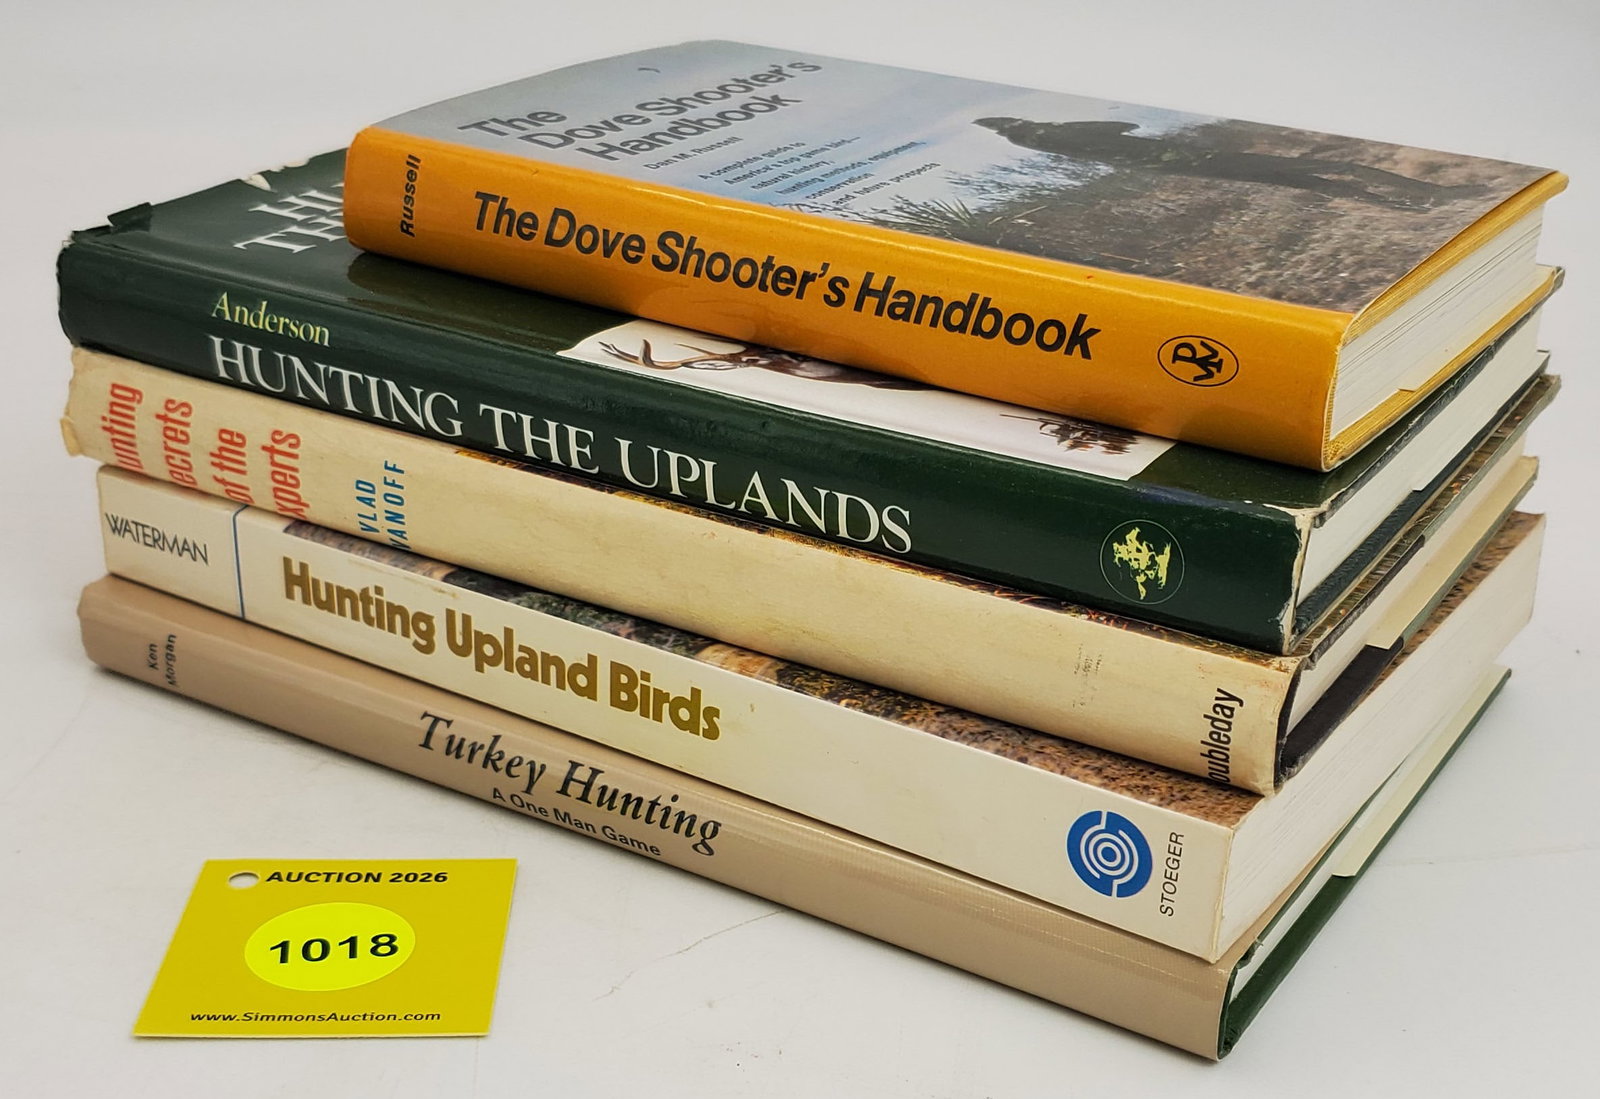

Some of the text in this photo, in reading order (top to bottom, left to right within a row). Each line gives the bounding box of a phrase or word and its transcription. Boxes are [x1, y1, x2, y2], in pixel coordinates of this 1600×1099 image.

[457, 110, 567, 136] The
[518, 60, 822, 150] Dove Shooter's
[576, 94, 803, 161] Handbook
[643, 136, 744, 170] Dan M. Russell
[710, 156, 763, 177] complete
[724, 164, 783, 185] America's
[400, 154, 421, 238] Russell
[751, 173, 793, 190] natural
[775, 177, 825, 195] hunting
[805, 172, 875, 199] conservation
[832, 162, 941, 205] and future prospects
[233, 213, 346, 254] TH
[475, 190, 1102, 361] The Dove Shooter's Handbook
[211, 291, 331, 348] Anderson
[101, 383, 143, 470] unting
[155, 398, 198, 487] ecrets
[208, 334, 913, 554] HUNTING THE UPLANDS
[209, 428, 255, 505] of the
[261, 429, 310, 520] xperts
[355, 479, 380, 533] VLAD
[383, 460, 412, 550] VANOFF
[105, 512, 209, 565] WATERMAN
[147, 643, 160, 671] Ken
[165, 633, 177, 686] Morgan
[282, 555, 721, 742] Hunting Upland Birds
[1200, 687, 1244, 784] oubleday
[418, 710, 722, 857] Turkey Hunting
[492, 787, 661, 856] A One Man Game
[266, 870, 449, 884] AUCTION 2026
[1159, 831, 1185, 918] STOEGER
[269, 933, 400, 966] 1018
[190, 1010, 442, 1023] www.SimmonsAuction.com
